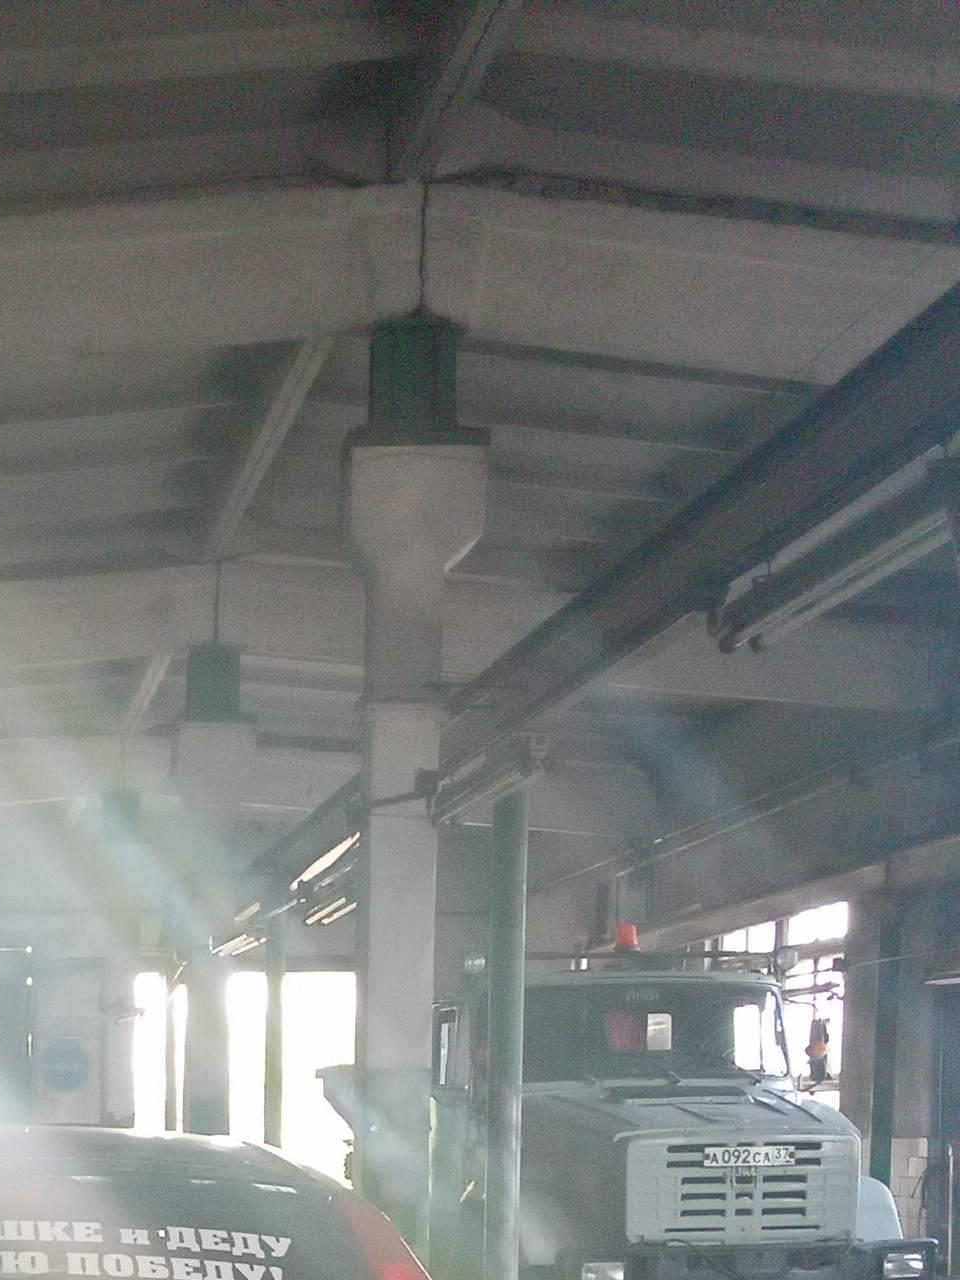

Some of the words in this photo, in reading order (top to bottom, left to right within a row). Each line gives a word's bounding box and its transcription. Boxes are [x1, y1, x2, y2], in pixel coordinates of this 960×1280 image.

[710, 1149, 771, 1165] А092СА
[775, 1147, 790, 1160] 37
[119, 1227, 152, 1246] и
[166, 1225, 292, 1259] ДЕДУ
